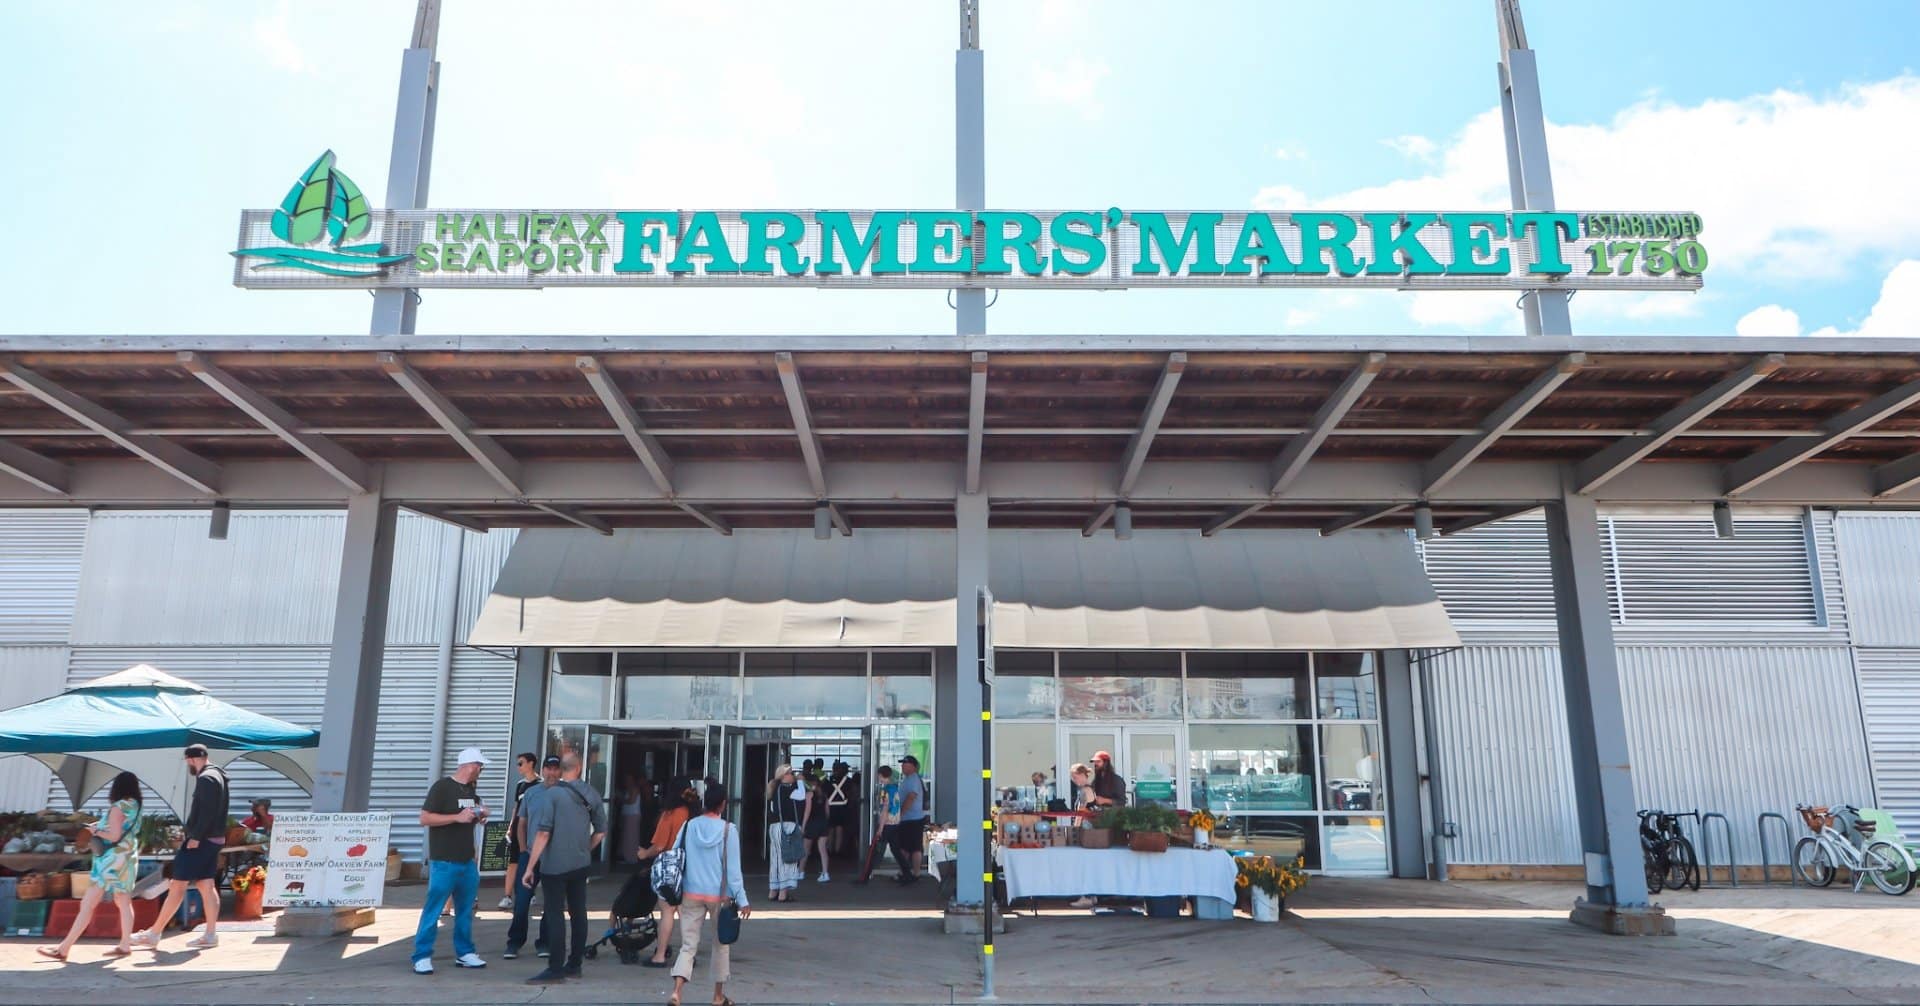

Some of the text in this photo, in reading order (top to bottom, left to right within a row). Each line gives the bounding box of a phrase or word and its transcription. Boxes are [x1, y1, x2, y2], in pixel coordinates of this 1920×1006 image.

[435, 213, 609, 242] HALIFAX
[1586, 213, 1703, 237] ESTABLISHED
[1130, 211, 1579, 276] MARKET
[414, 242, 609, 273] SEAPORT
[1584, 240, 1708, 275] 1750
[275, 814, 330, 822] OAKVIEW FARM
[333, 814, 390, 822] OAKVIEW FARM
[269, 860, 325, 868] OAKVIEW FARM
[327, 860, 385, 868] OAKVIEW FARM
[344, 874, 365, 882] EGGS
